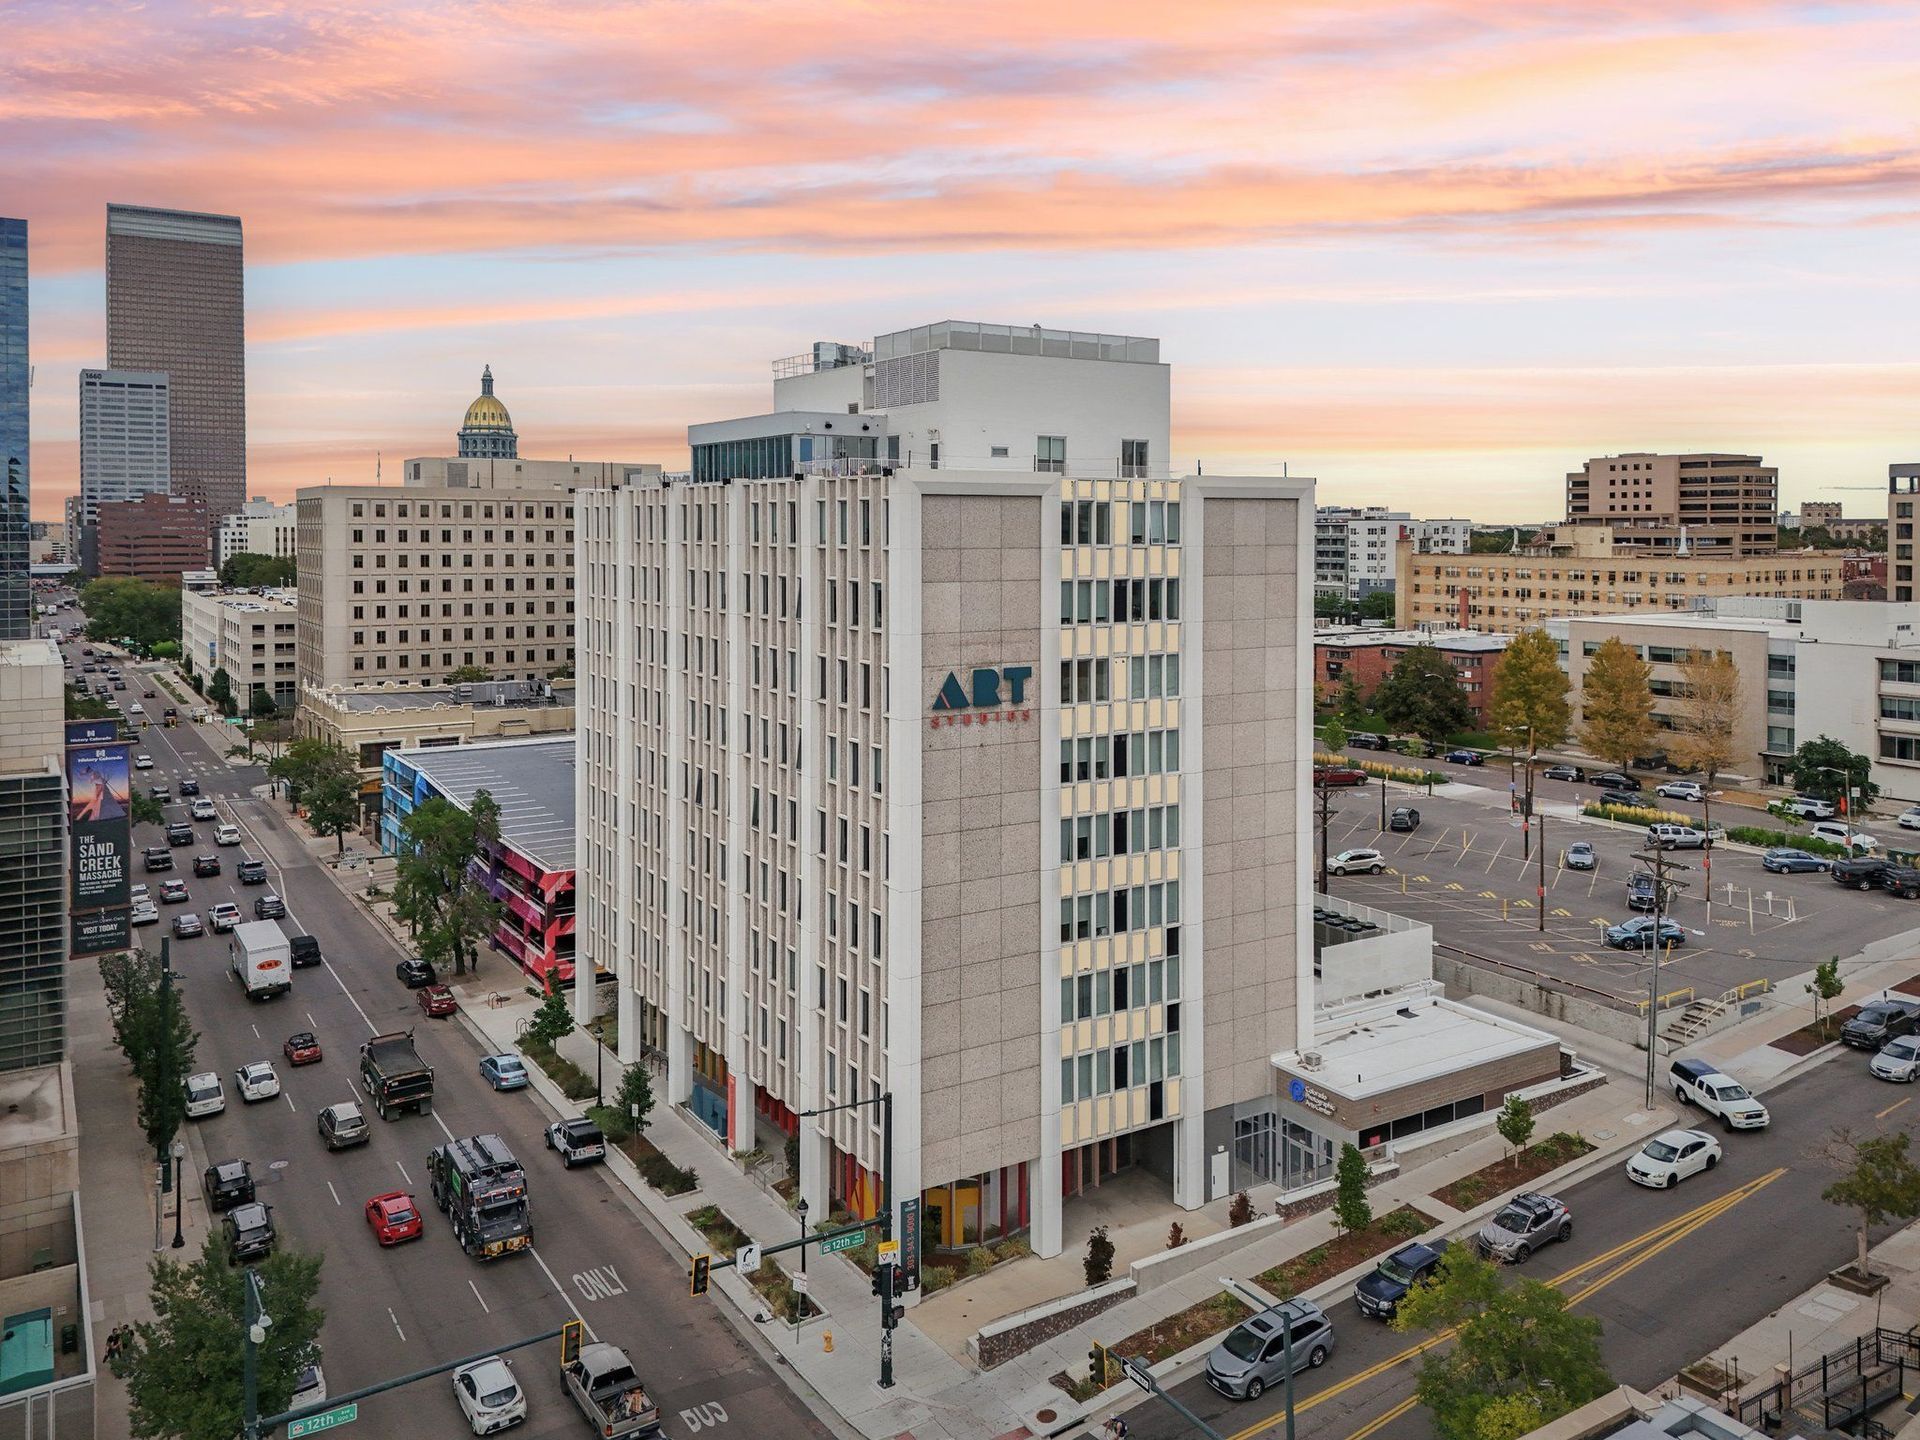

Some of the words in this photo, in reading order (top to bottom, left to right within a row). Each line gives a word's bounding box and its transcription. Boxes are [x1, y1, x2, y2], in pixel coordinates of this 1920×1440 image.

[932, 667, 1032, 710] ART
[930, 708, 1030, 729] STUDIOS
[79, 835, 95, 844] THE
[79, 842, 114, 858] SAND
[79, 855, 121, 872] CREEK
[79, 869, 122, 881] MASSACRE
[82, 926, 98, 935] VISIT
[99, 923, 118, 932] TODAY
[1305, 1086, 1328, 1101] Colorado
[832, 1237, 850, 1250] 12th
[572, 1264, 629, 1301] ONLY
[307, 1414, 334, 1431] 12th
